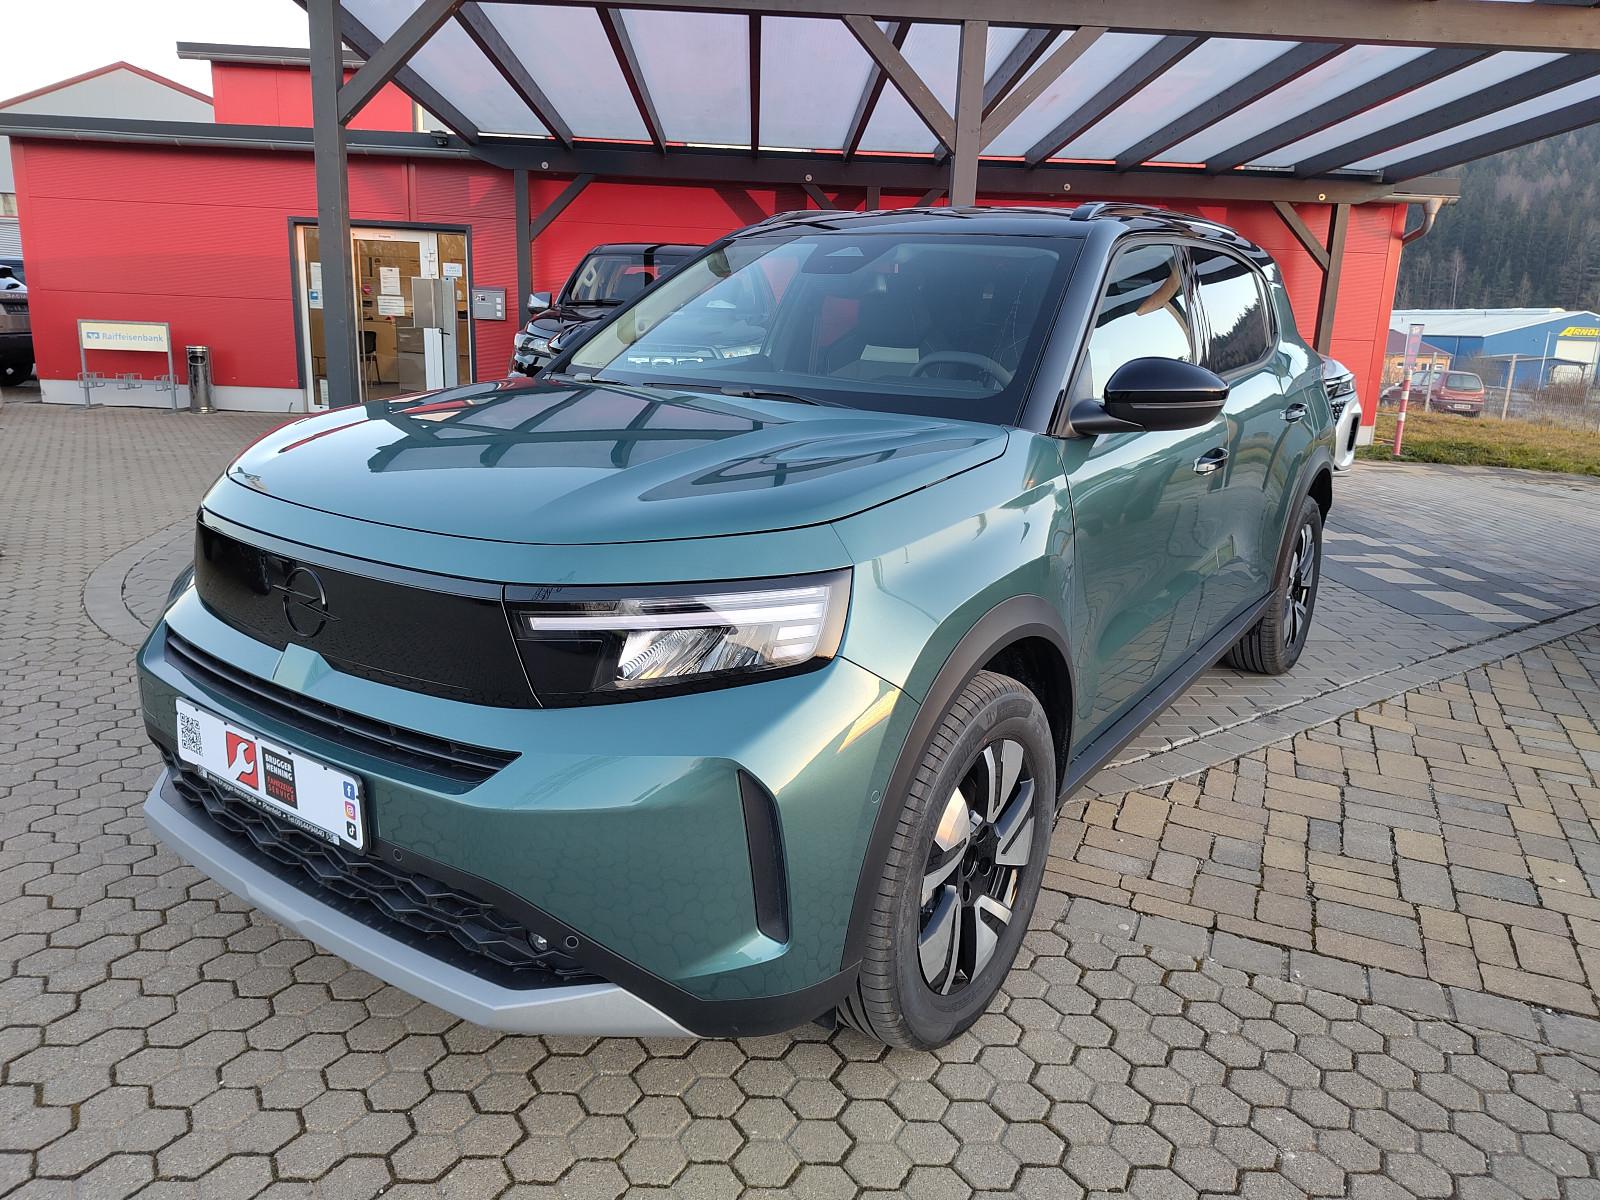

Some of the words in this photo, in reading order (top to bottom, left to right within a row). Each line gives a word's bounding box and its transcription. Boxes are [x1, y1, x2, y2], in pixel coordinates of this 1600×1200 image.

[102, 332, 163, 343] Raiffeisenbank
[264, 753, 292, 772] BRUGGER
[265, 762, 293, 781] HENNING
[267, 775, 294, 794] FAHRZEUG
[268, 784, 295, 802] SERVICE
